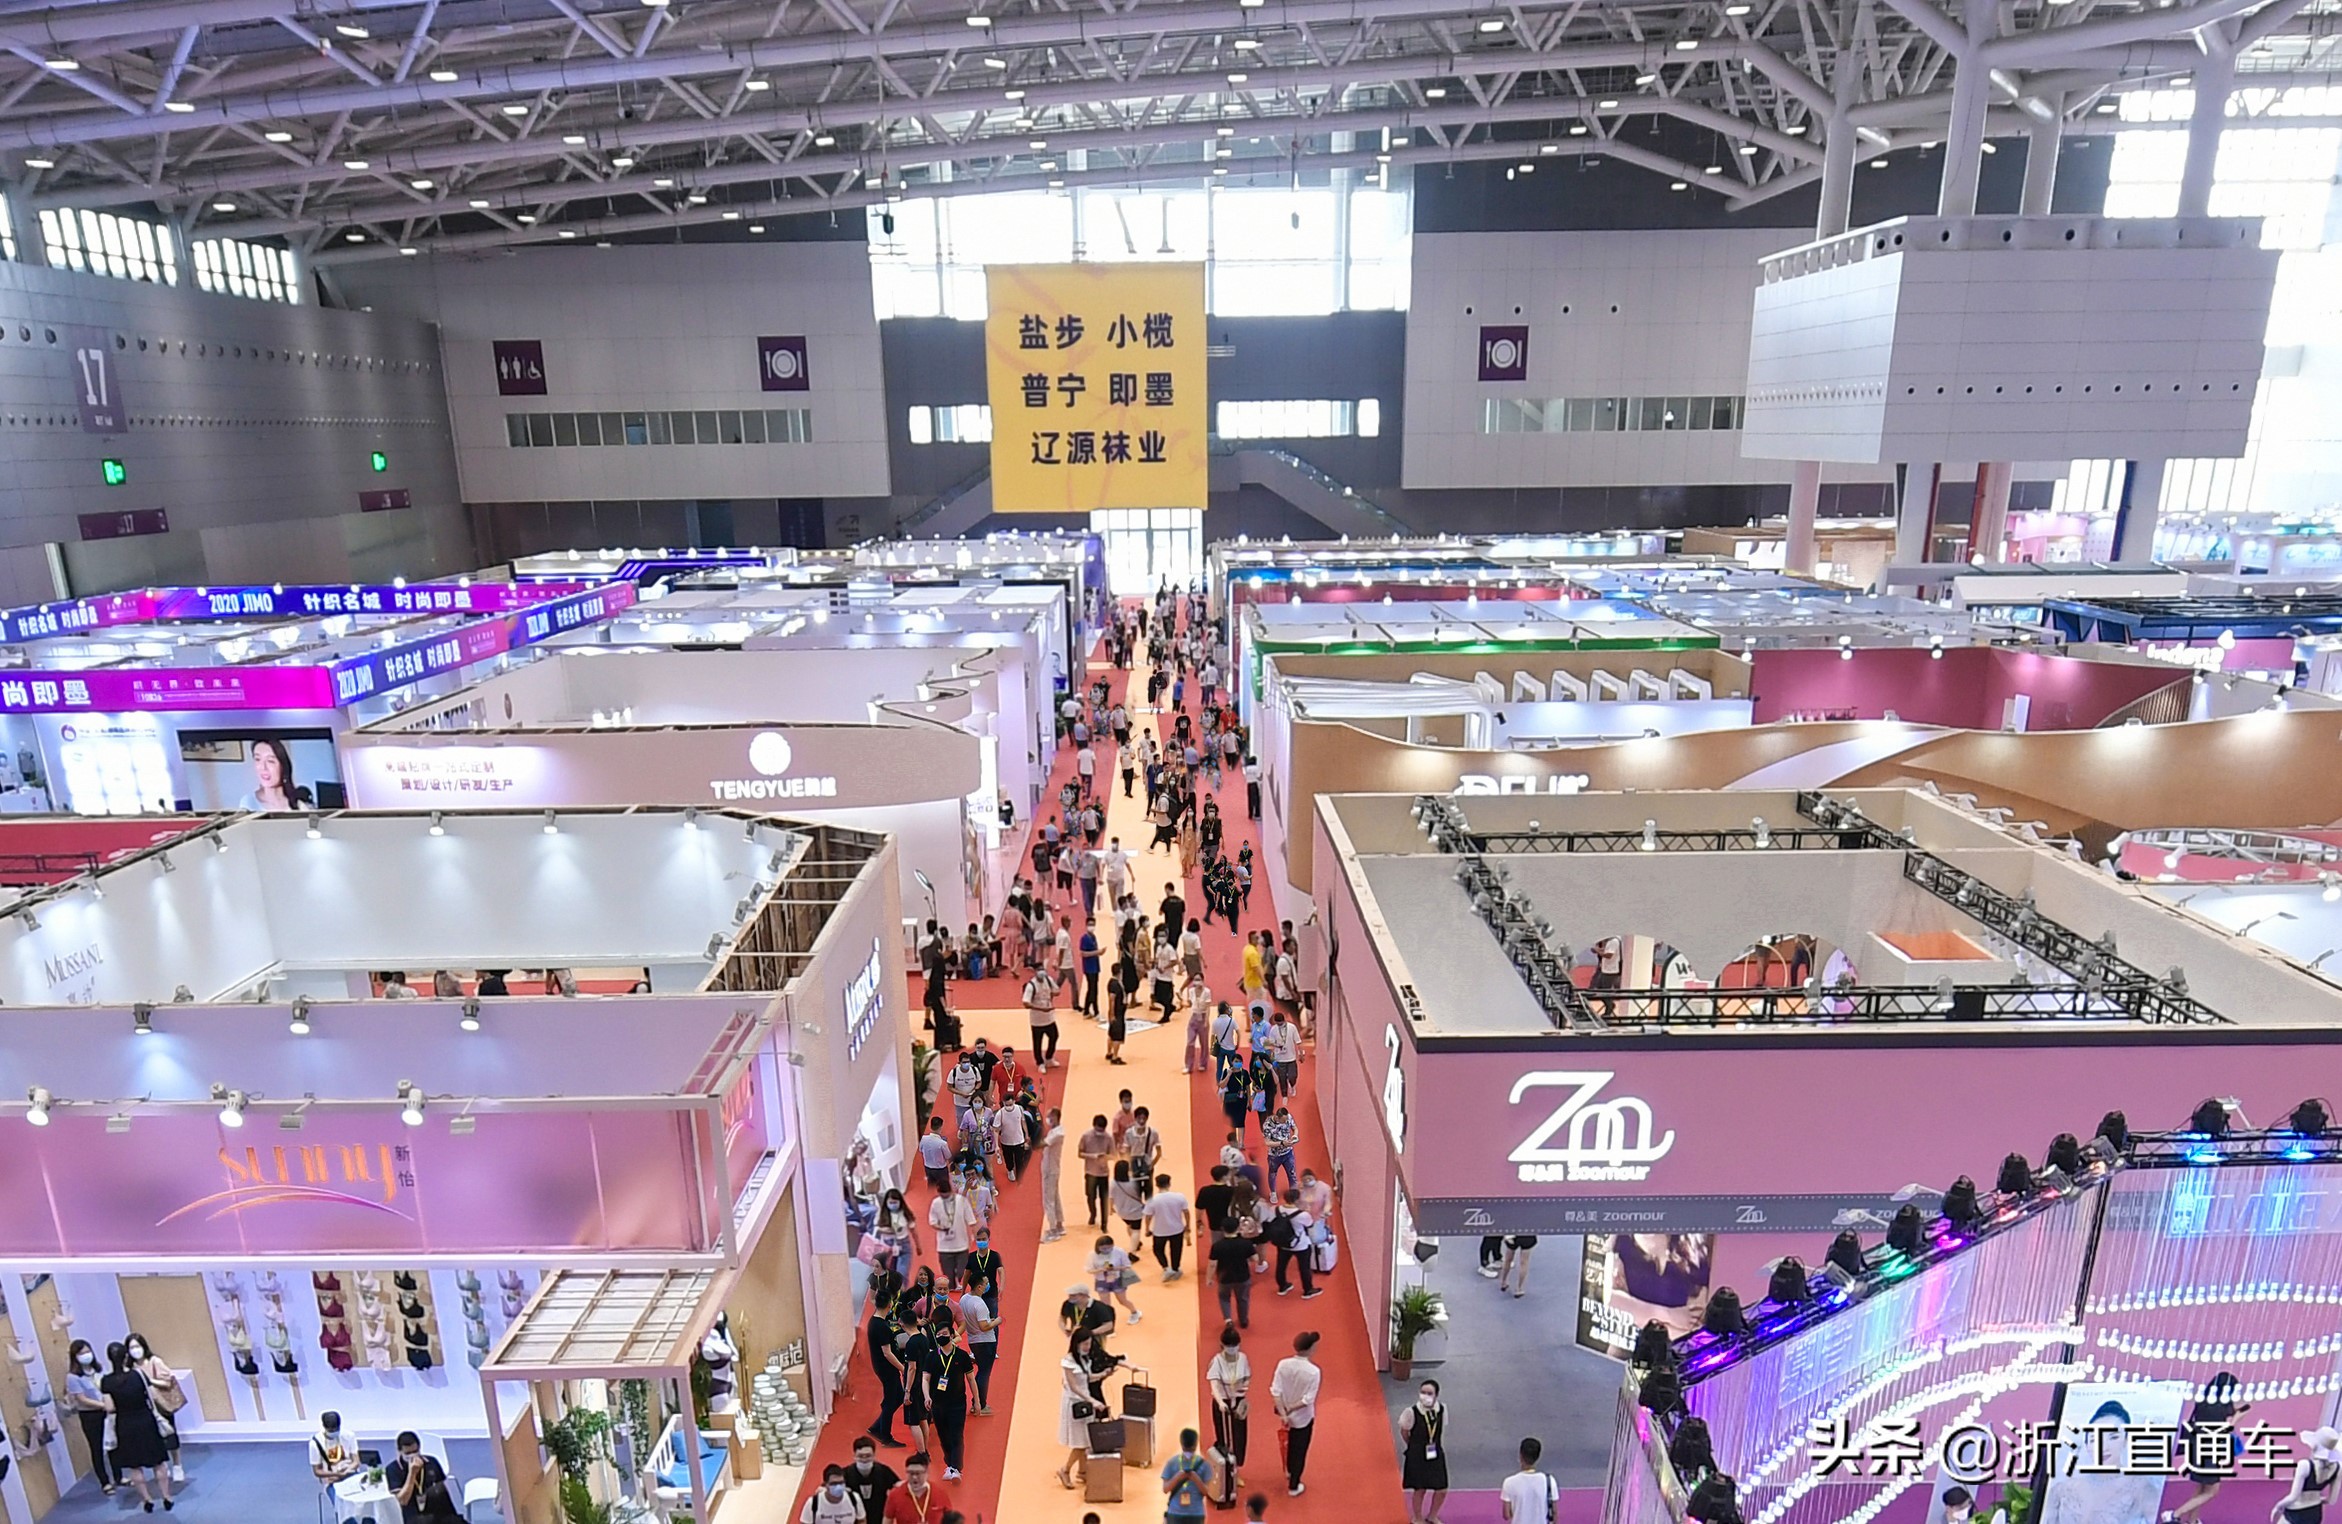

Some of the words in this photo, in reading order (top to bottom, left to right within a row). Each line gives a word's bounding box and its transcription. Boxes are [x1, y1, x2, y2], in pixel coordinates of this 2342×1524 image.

[1019, 314, 1085, 350] 盐步
[1107, 313, 1175, 349] 小榄
[77, 348, 107, 406] 17
[1021, 372, 1086, 408] 普宁
[1109, 372, 1174, 407] 即墨
[1031, 430, 1167, 465] 辽源袜业
[209, 594, 240, 613] 2020
[242, 593, 273, 613] JIMO
[303, 592, 381, 611] 针织名城
[395, 590, 472, 610] 时尚即墨
[1602, 1211, 1667, 1222] zoomour
